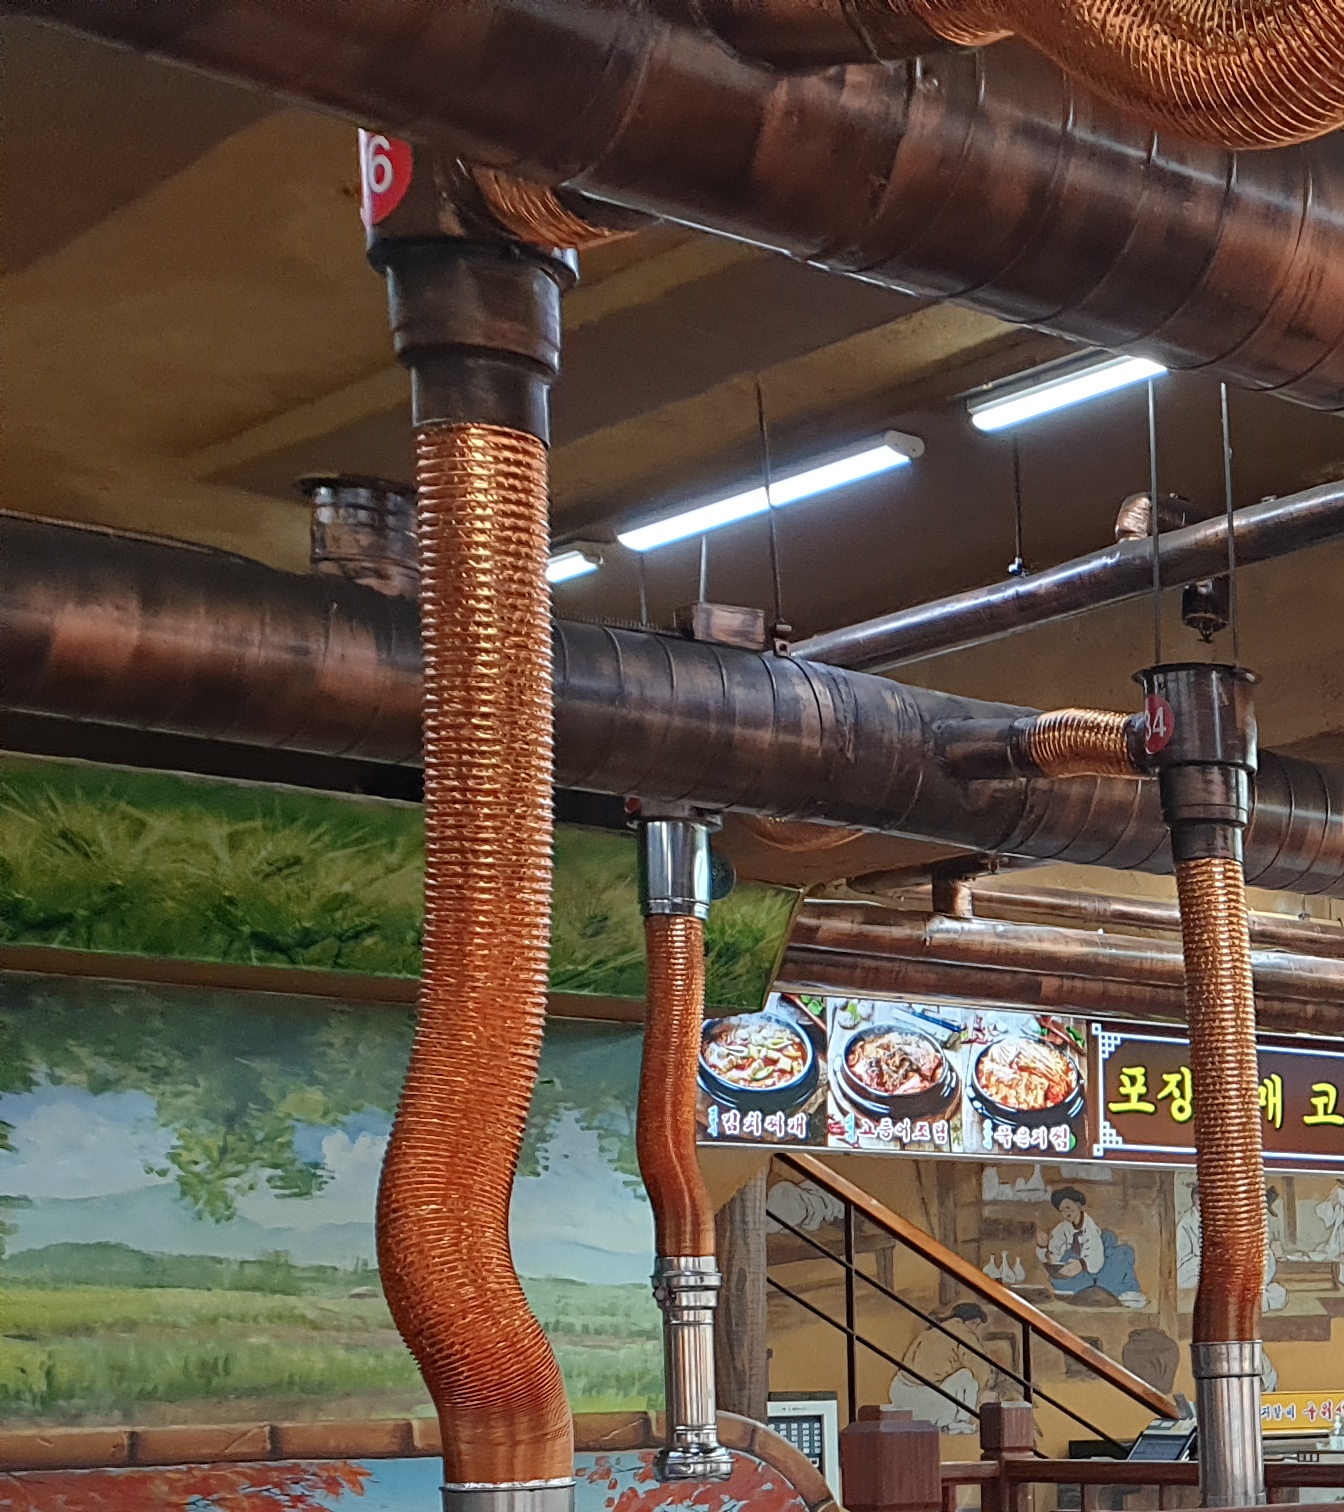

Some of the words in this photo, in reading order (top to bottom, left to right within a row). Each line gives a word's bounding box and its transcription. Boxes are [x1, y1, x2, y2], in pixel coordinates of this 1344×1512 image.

[722, 1109, 808, 1139] 김치찌개
[858, 1117, 949, 1145] 고등어조림
[994, 1122, 1072, 1152] 묵은지찜
